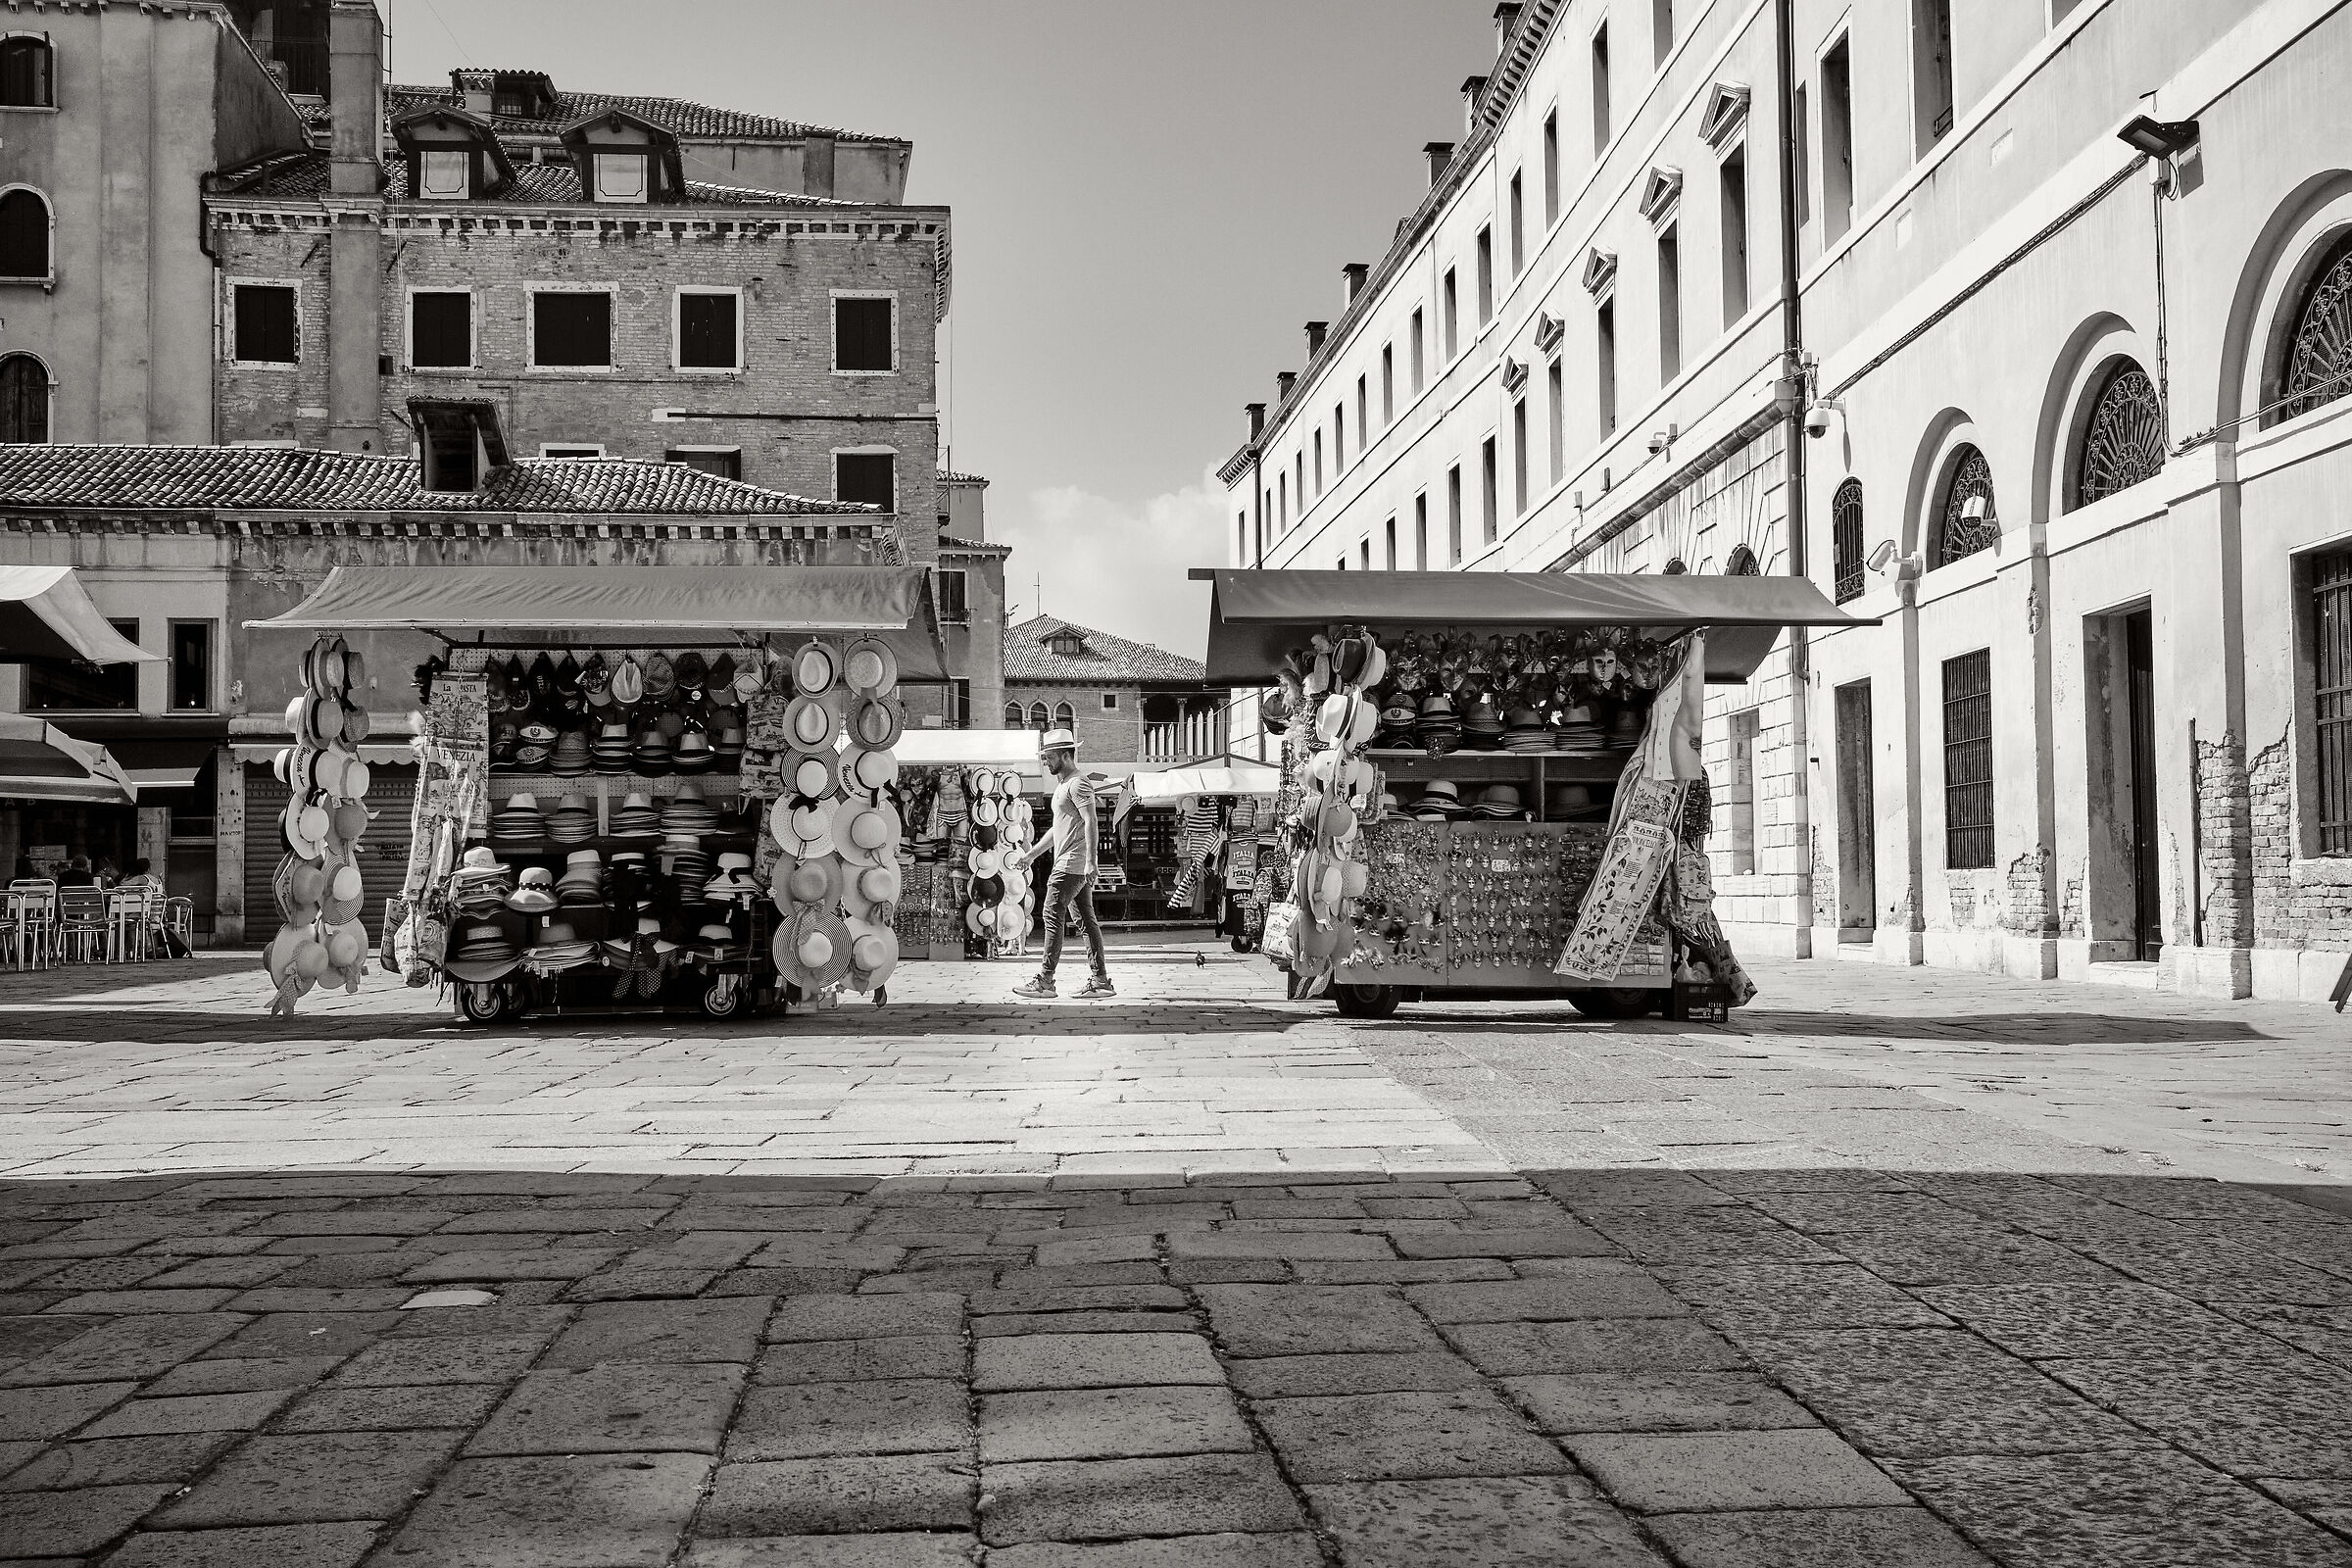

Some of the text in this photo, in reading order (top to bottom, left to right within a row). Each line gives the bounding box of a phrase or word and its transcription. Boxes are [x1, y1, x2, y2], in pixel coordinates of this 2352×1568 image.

[443, 683, 451, 692] La
[296, 746, 311, 772] Venezia
[437, 748, 476, 762] VENEZIA
[842, 763, 855, 792] Venezia
[1233, 850, 1255, 859] ITALIA
[1232, 869, 1254, 878] ITALIA
[1232, 892, 1251, 903] ITALI
